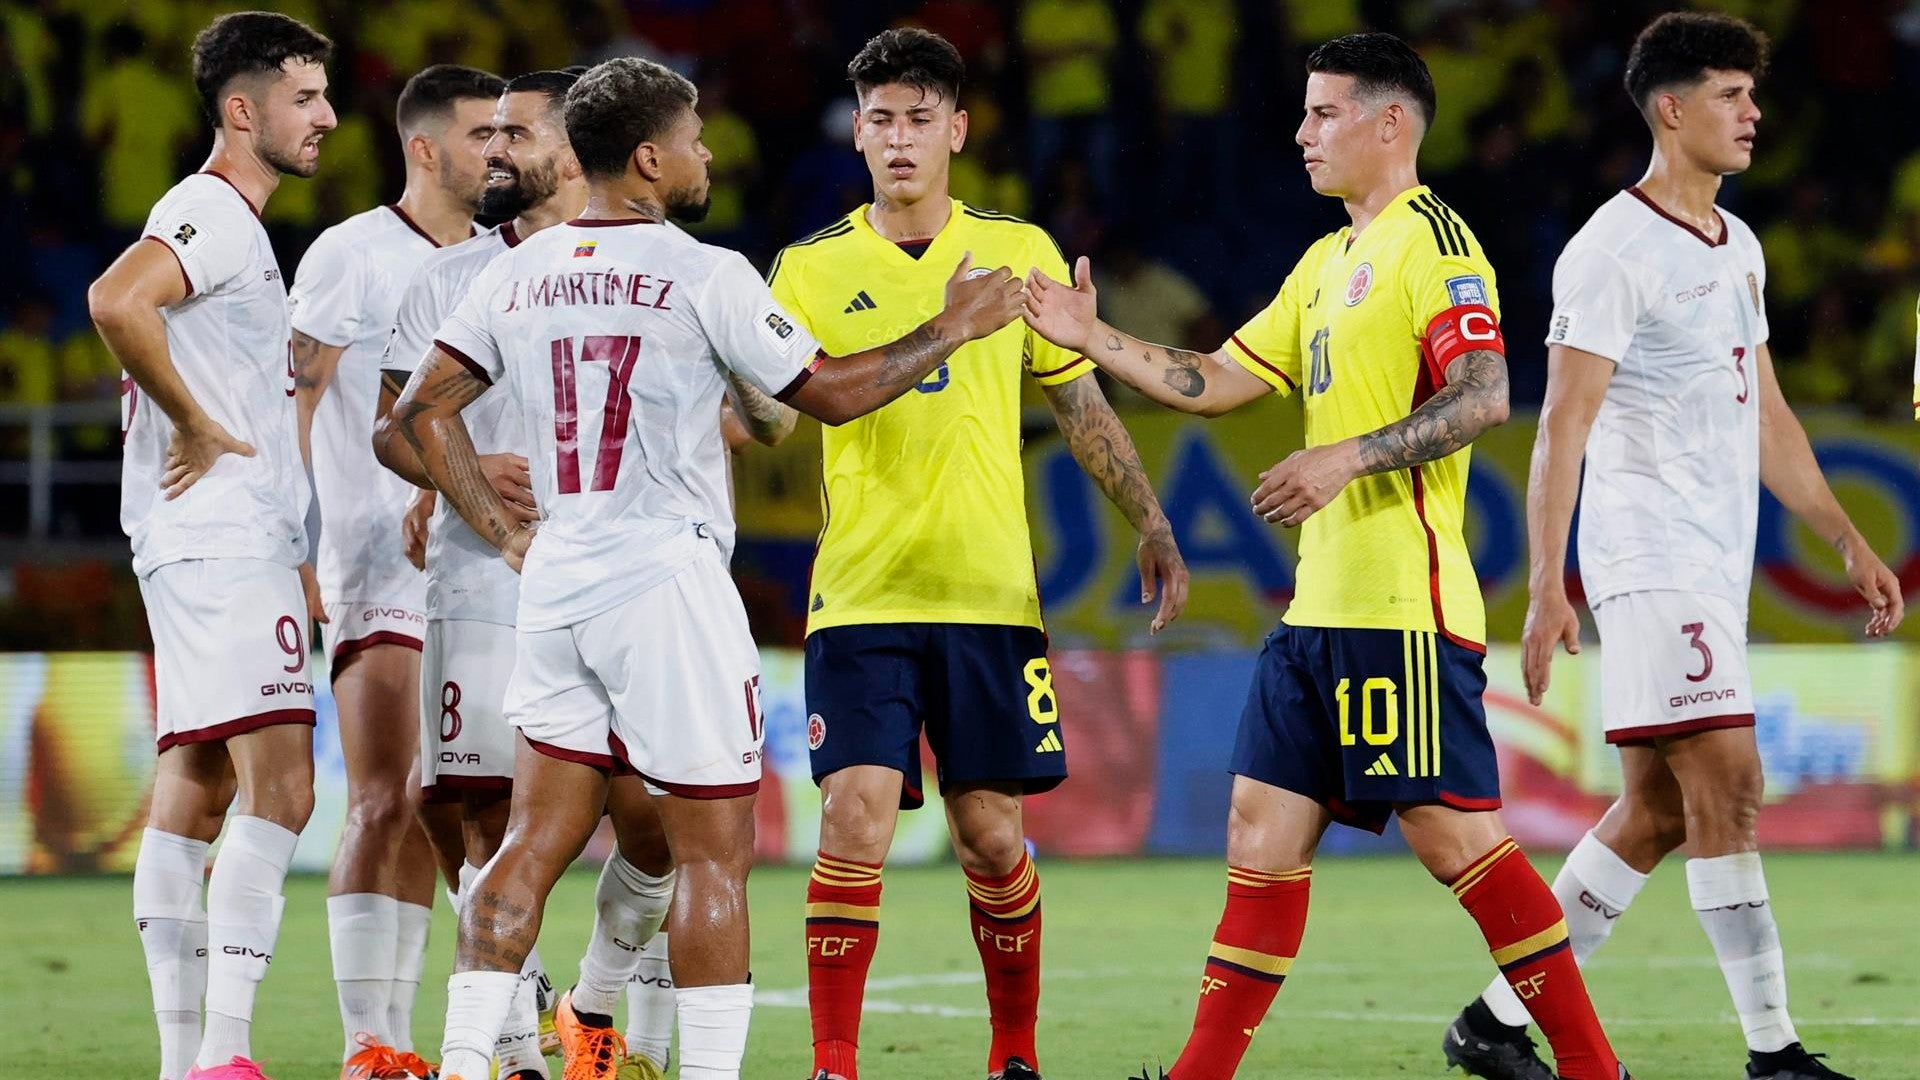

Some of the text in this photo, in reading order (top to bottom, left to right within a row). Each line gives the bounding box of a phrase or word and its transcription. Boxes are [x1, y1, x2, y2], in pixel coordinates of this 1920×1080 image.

[502, 267, 674, 313] J. MARTÍNEZ
[1459, 311, 1496, 341] C
[1308, 327, 1332, 397] 10
[1732, 347, 1748, 404] 3
[551, 335, 642, 495] 17
[362, 607, 425, 624] GIVOVA
[276, 615, 305, 674] 9
[1681, 622, 1713, 682] 3
[1023, 657, 1059, 725] 8
[1670, 689, 1735, 708] GIVOVA
[440, 680, 462, 743] 8
[1335, 677, 1399, 746] 10
[440, 751, 481, 765] OVA
[808, 937, 860, 956] FCF
[978, 925, 1035, 952] FCF
[628, 974, 672, 989] IVO
[1511, 970, 1546, 1000] CF
[494, 1031, 536, 1046] OVA
